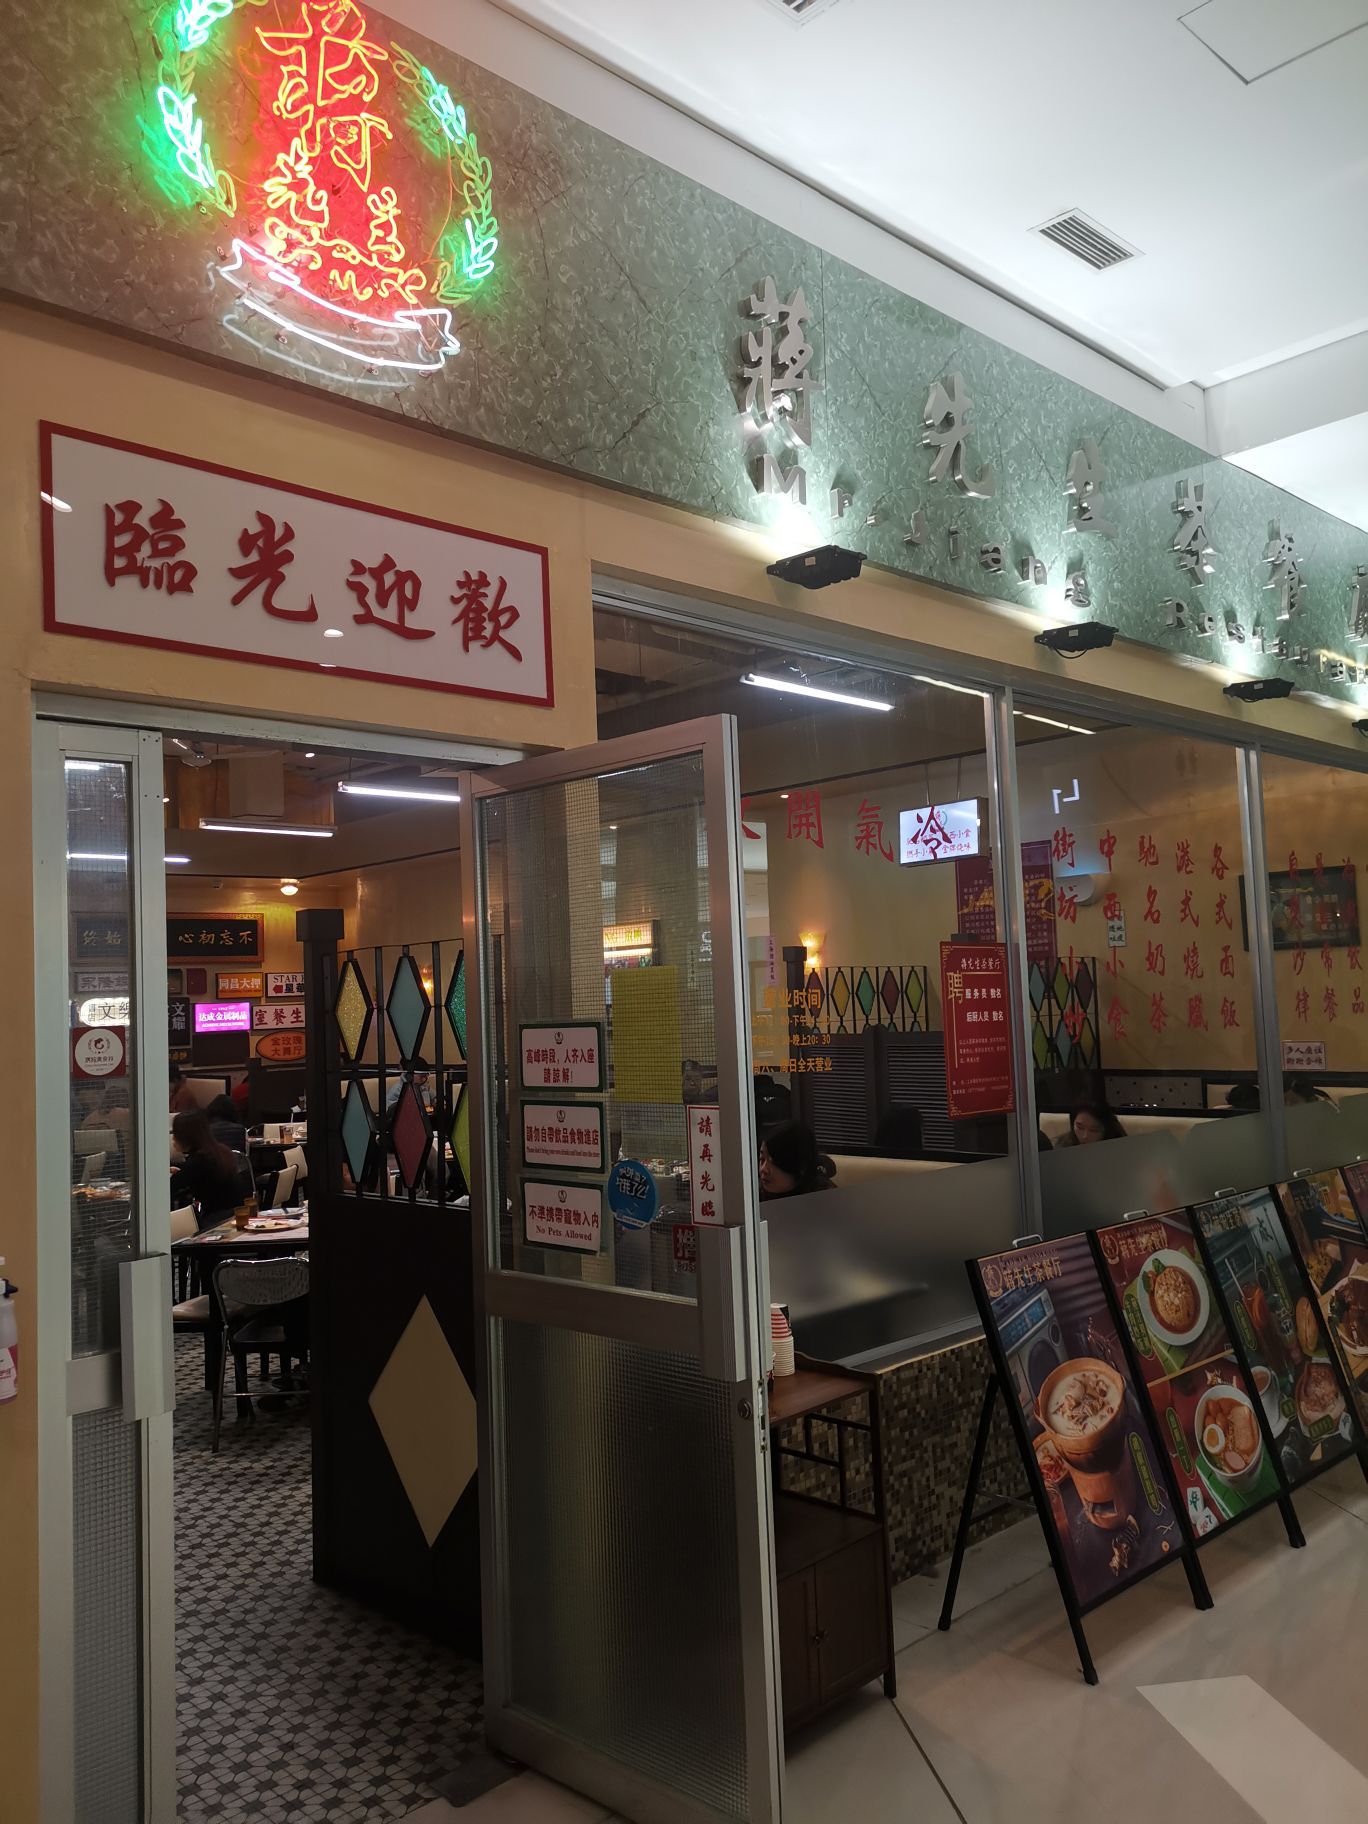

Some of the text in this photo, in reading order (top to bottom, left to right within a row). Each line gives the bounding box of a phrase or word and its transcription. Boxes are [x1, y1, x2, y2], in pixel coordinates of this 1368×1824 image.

[535, 1224, 593, 1242] No Pets Allowed
